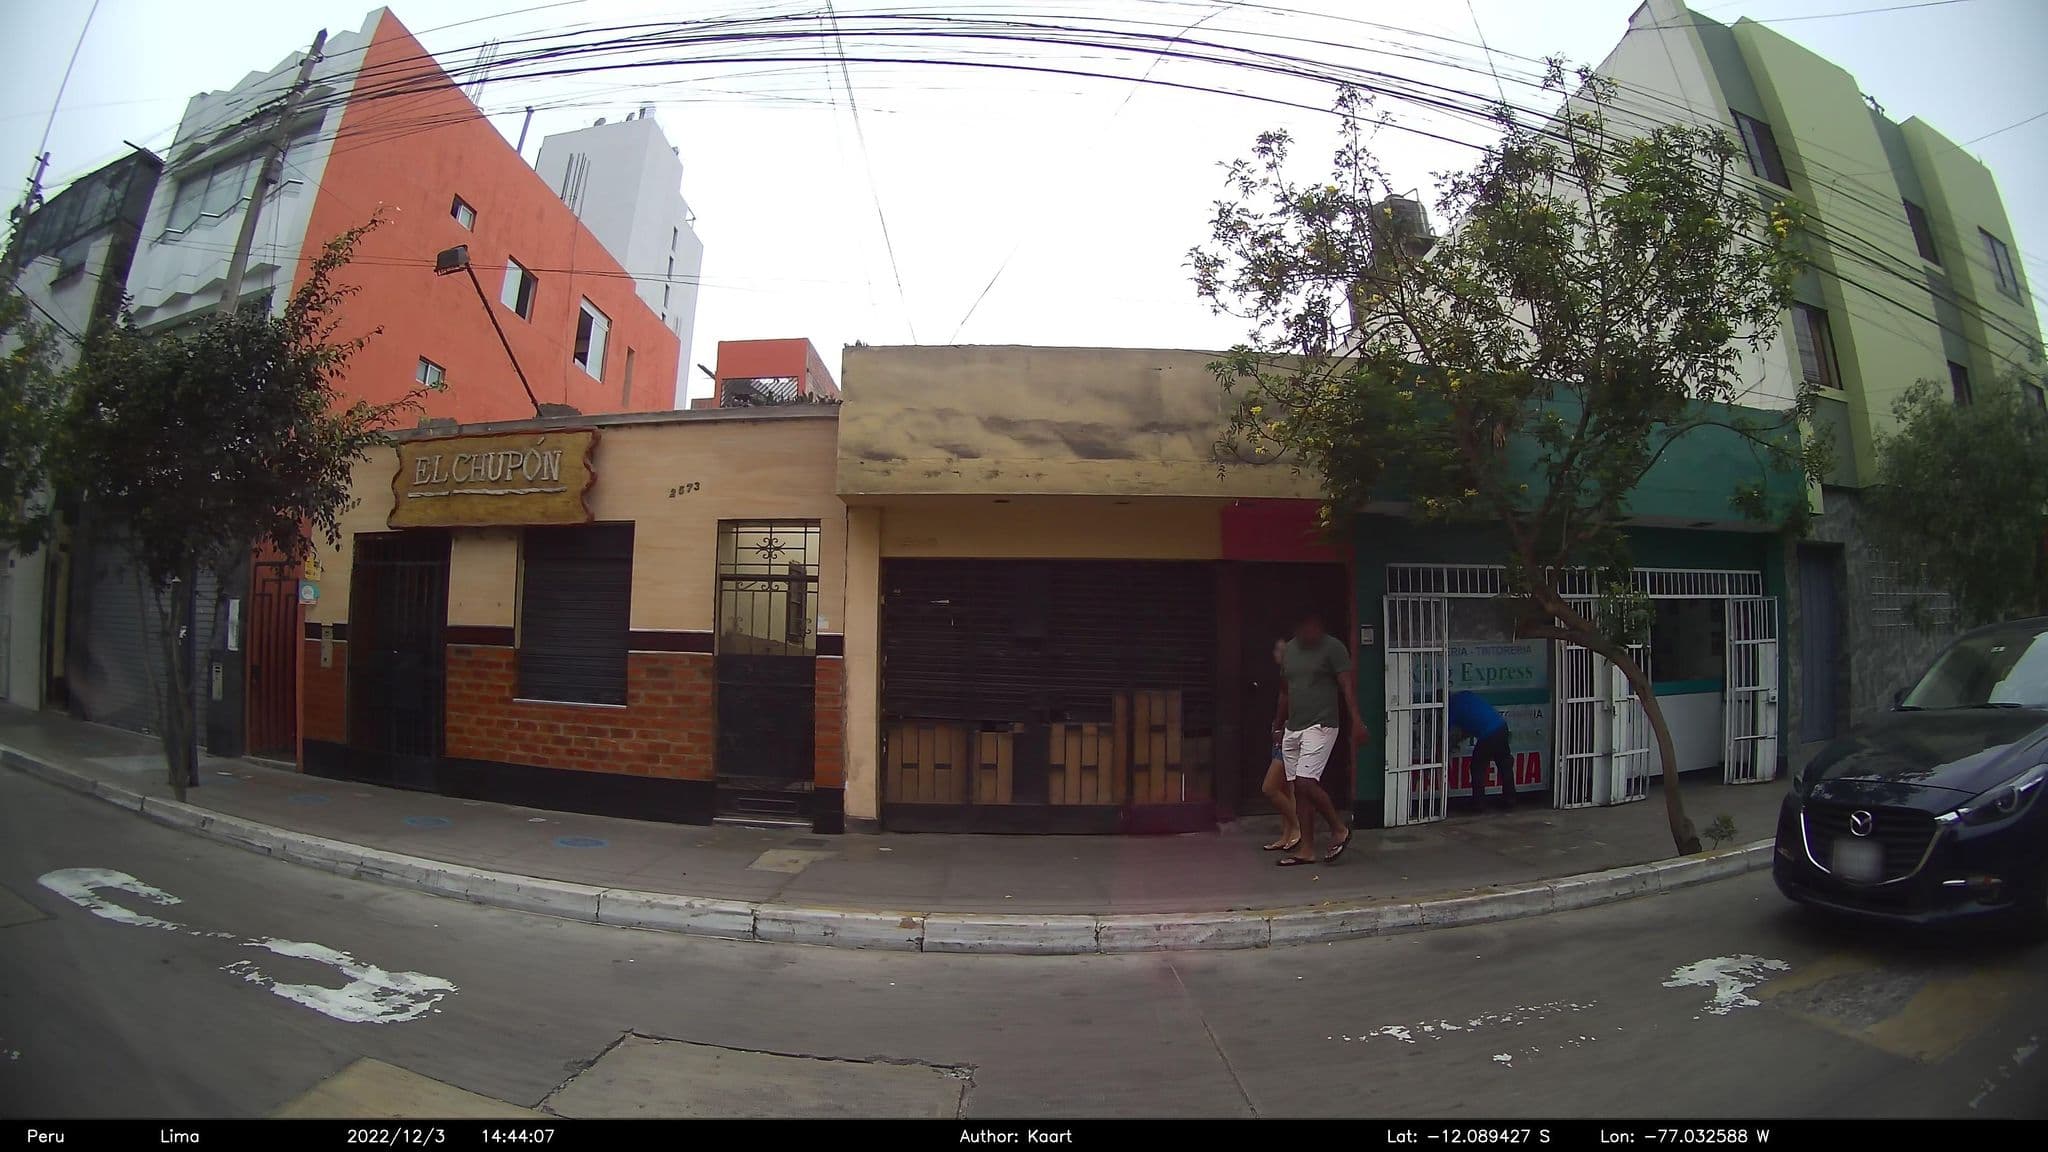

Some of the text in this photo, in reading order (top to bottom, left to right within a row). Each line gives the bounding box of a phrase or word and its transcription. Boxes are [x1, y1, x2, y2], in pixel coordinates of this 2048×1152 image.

[413, 437, 563, 486] EL CHUPÓN
[668, 481, 701, 498] 2573
[1461, 662, 1533, 686] Express
